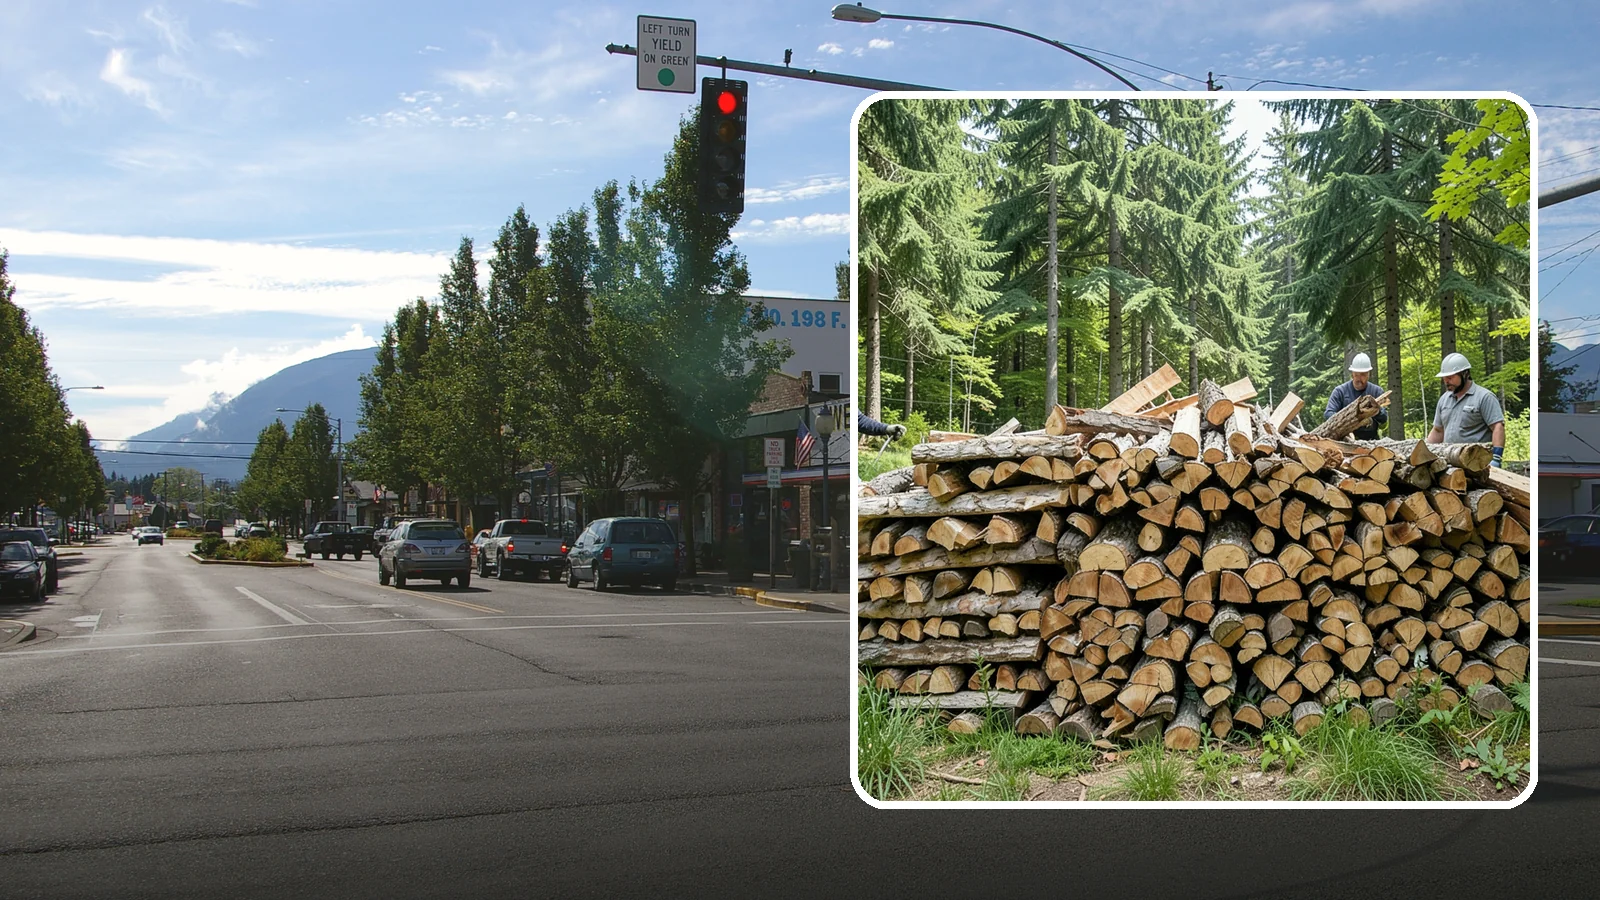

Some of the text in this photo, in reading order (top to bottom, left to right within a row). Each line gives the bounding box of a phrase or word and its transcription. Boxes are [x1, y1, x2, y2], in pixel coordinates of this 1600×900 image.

[643, 23, 690, 36] LEFT TURN
[652, 38, 682, 51] YIELD
[644, 53, 689, 66] ON GREEN
[791, 309, 826, 328] 198
[831, 311, 847, 329] F.
